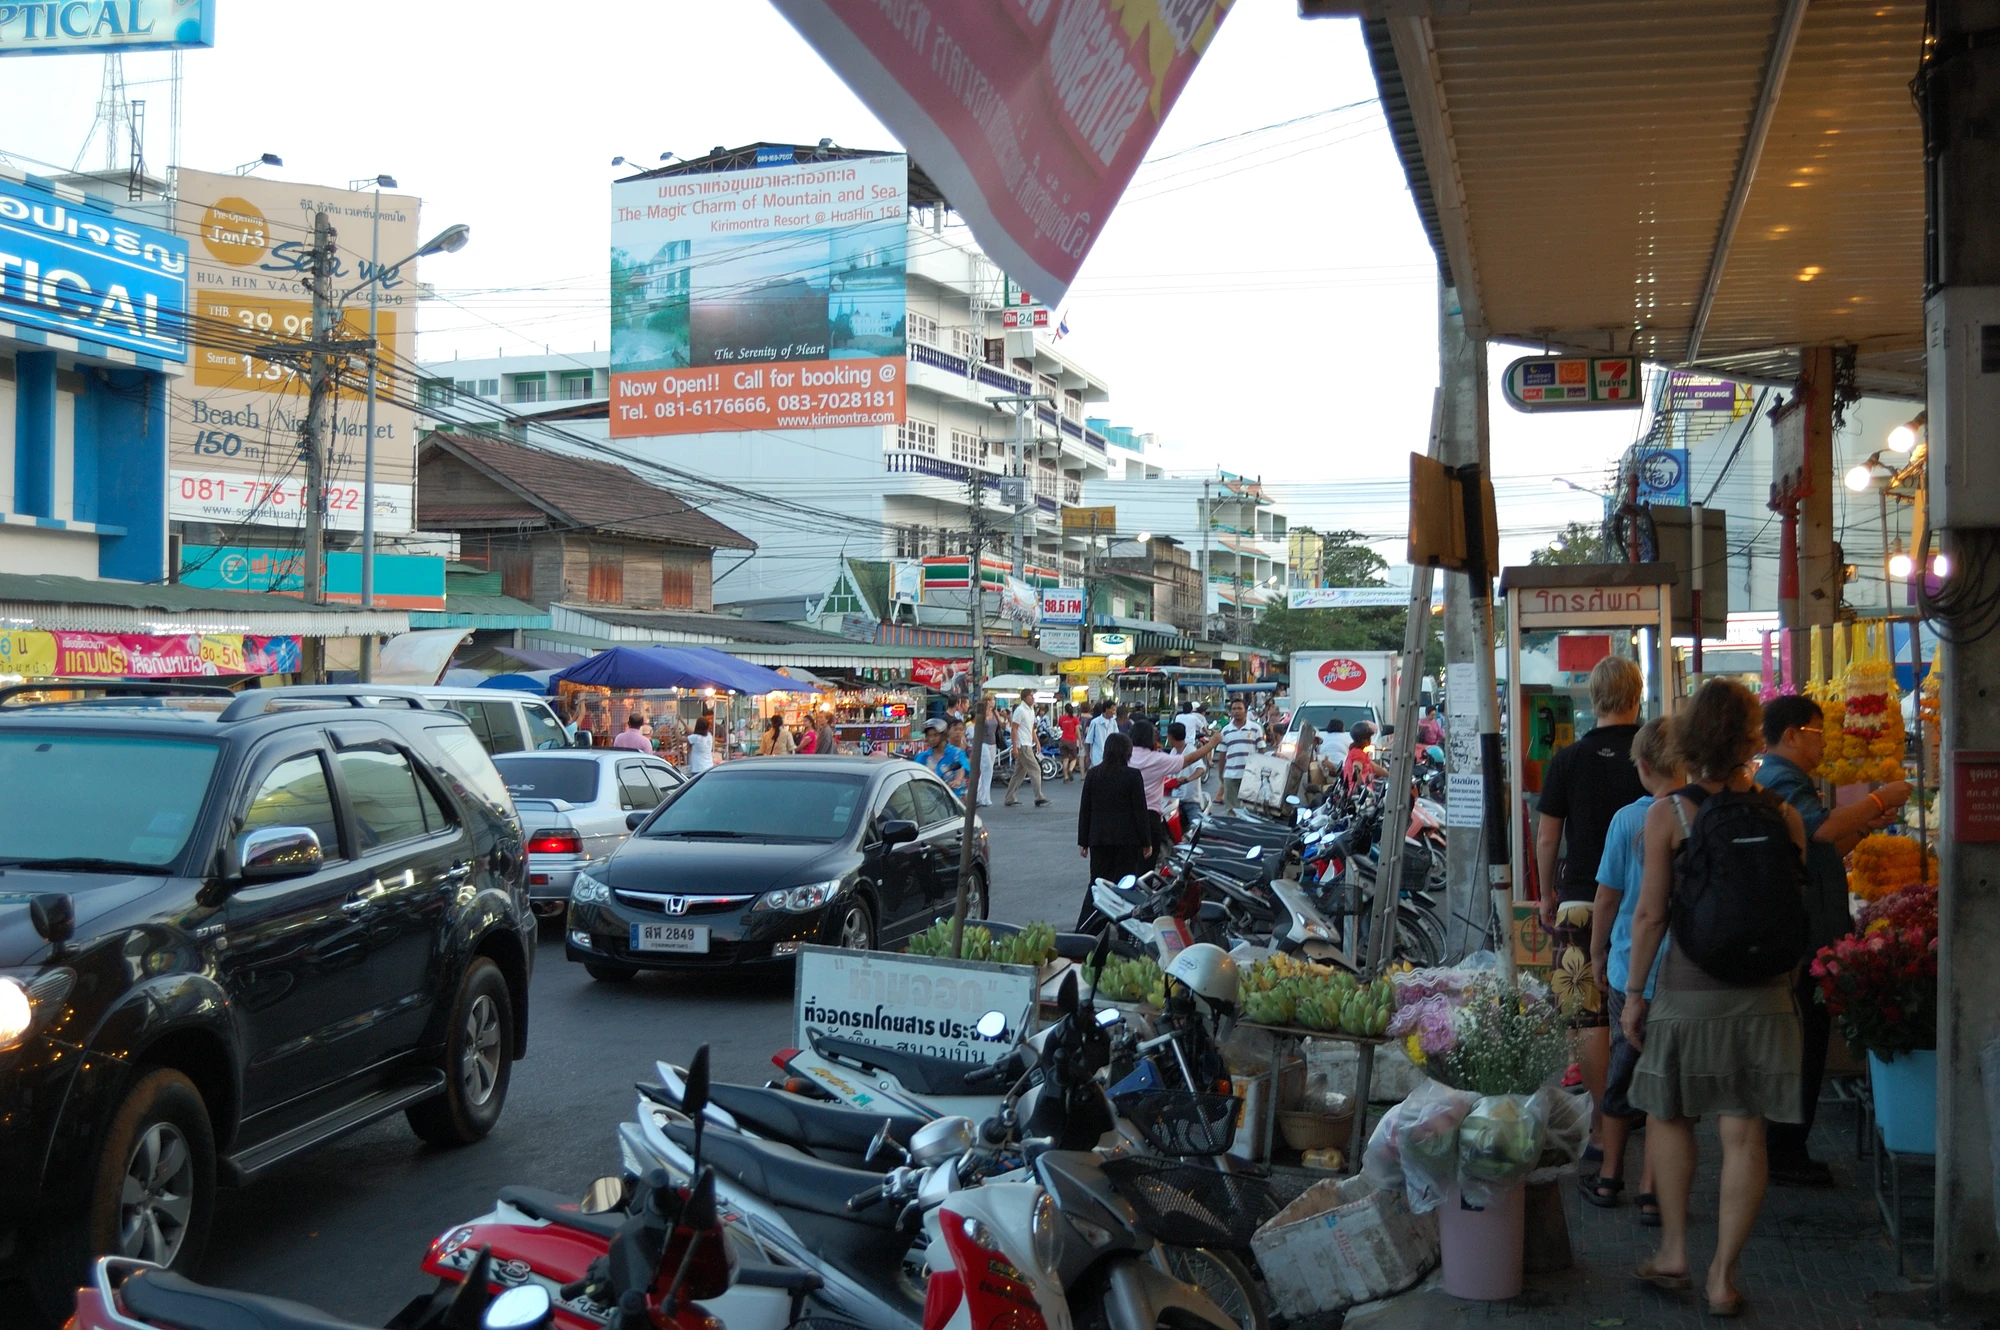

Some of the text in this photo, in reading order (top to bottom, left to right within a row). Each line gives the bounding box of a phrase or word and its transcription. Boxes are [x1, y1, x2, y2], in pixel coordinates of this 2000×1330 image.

[658, 167, 856, 198] มนตราแห่งขุนเขาและท้องทะเล
[618, 184, 900, 222] The Magic Charm of Mountain and Sea.
[711, 205, 900, 232] Kirimontra Resort @ HuaHin 156
[197, 272, 224, 285] HUA
[232, 276, 258, 289] HIN
[209, 305, 231, 317] THB.
[1019, 313, 1032, 324] 24
[207, 353, 227, 364] Start
[228, 356, 237, 365] at
[714, 344, 825, 361] The Serenity of Heart
[620, 364, 896, 397] Now Open!! Call for booking @
[1598, 379, 1628, 387] ELEVEN
[1694, 390, 1731, 398] EXCHANGE
[620, 391, 895, 420] Tel. 081-6176666, 083-7028181
[192, 400, 260, 429] Beach
[777, 412, 895, 427] www.kirimontra.com
[194, 430, 242, 457] 150
[1045, 600, 1081, 613] 98.5 FM
[65, 644, 202, 674] แถมฟรี! เสื้อกันหนาว
[202, 646, 215, 662] 30
[222, 648, 239, 667] 50
[666, 927, 694, 940] 2849
